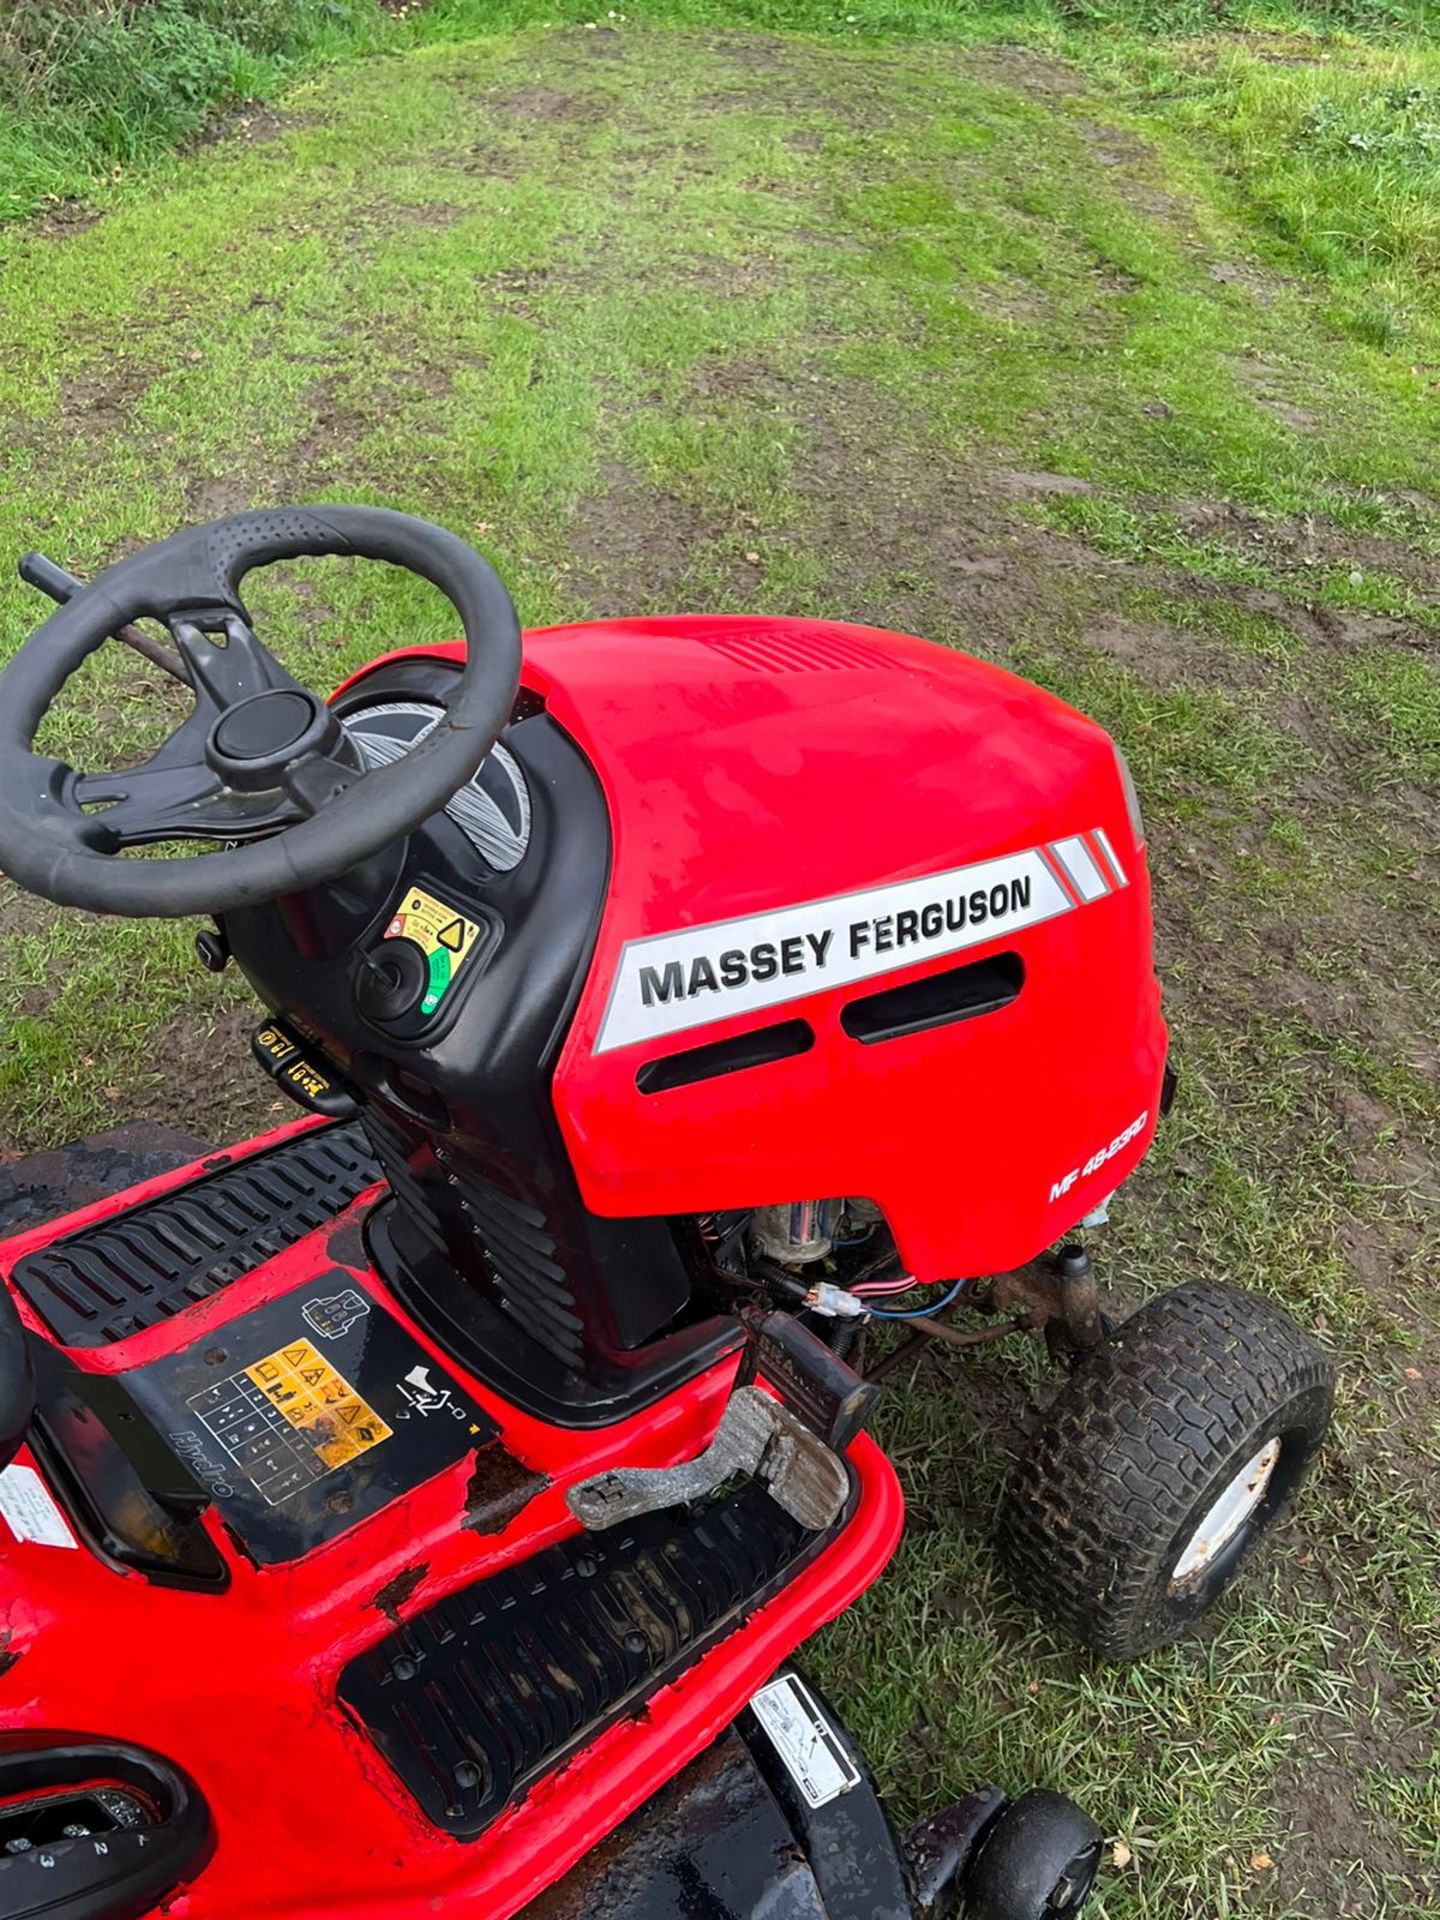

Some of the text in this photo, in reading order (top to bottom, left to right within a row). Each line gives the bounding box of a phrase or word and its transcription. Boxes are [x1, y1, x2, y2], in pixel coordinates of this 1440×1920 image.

[639, 875, 1032, 1006] MASSEY FERGUSON
[1048, 1168, 1079, 1203] MF
[169, 1431, 235, 1498] Hydro
[40, 1854, 56, 1869] 3
[94, 1842, 109, 1856] 2
